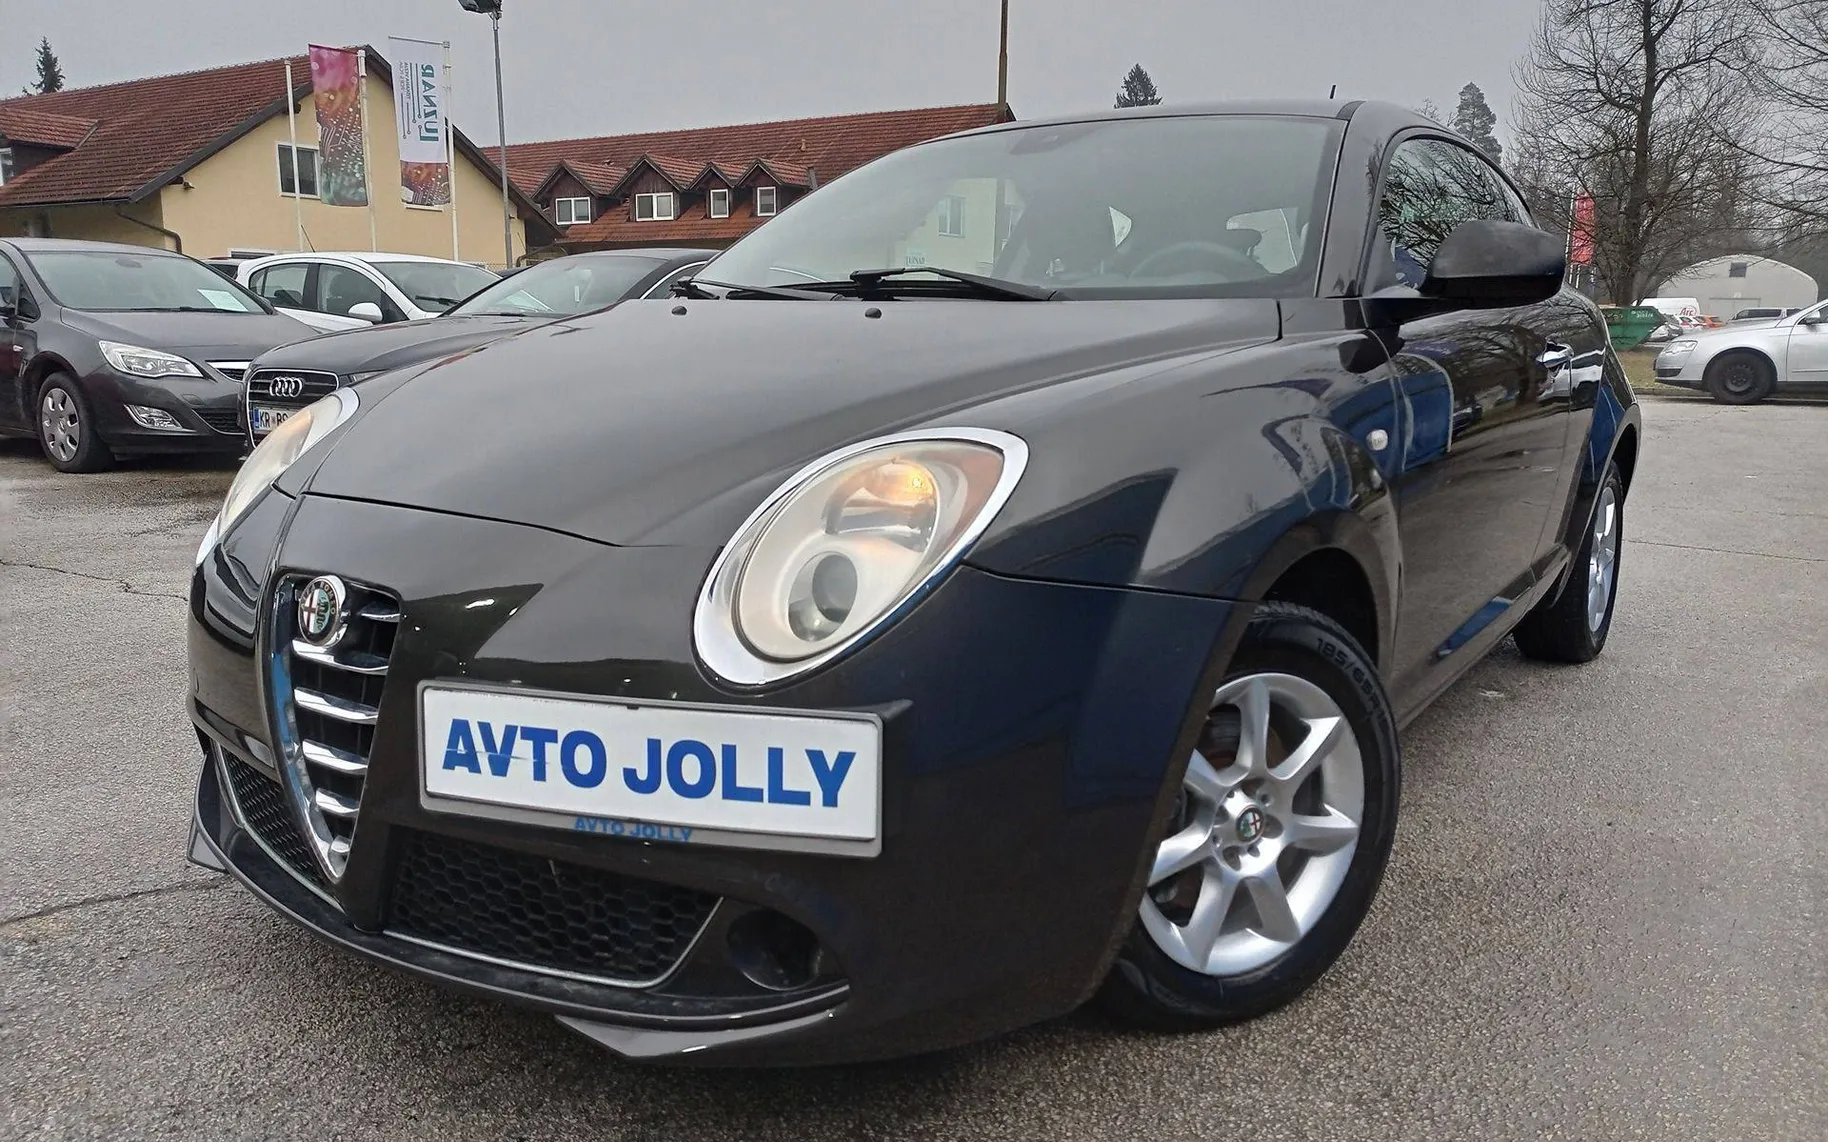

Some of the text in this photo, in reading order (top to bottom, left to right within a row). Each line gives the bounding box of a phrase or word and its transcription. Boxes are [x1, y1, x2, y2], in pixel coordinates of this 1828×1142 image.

[259, 411, 271, 428] KR
[441, 718, 857, 808] AVTO JOLLY
[574, 816, 693, 843] AVTO JOLLY
